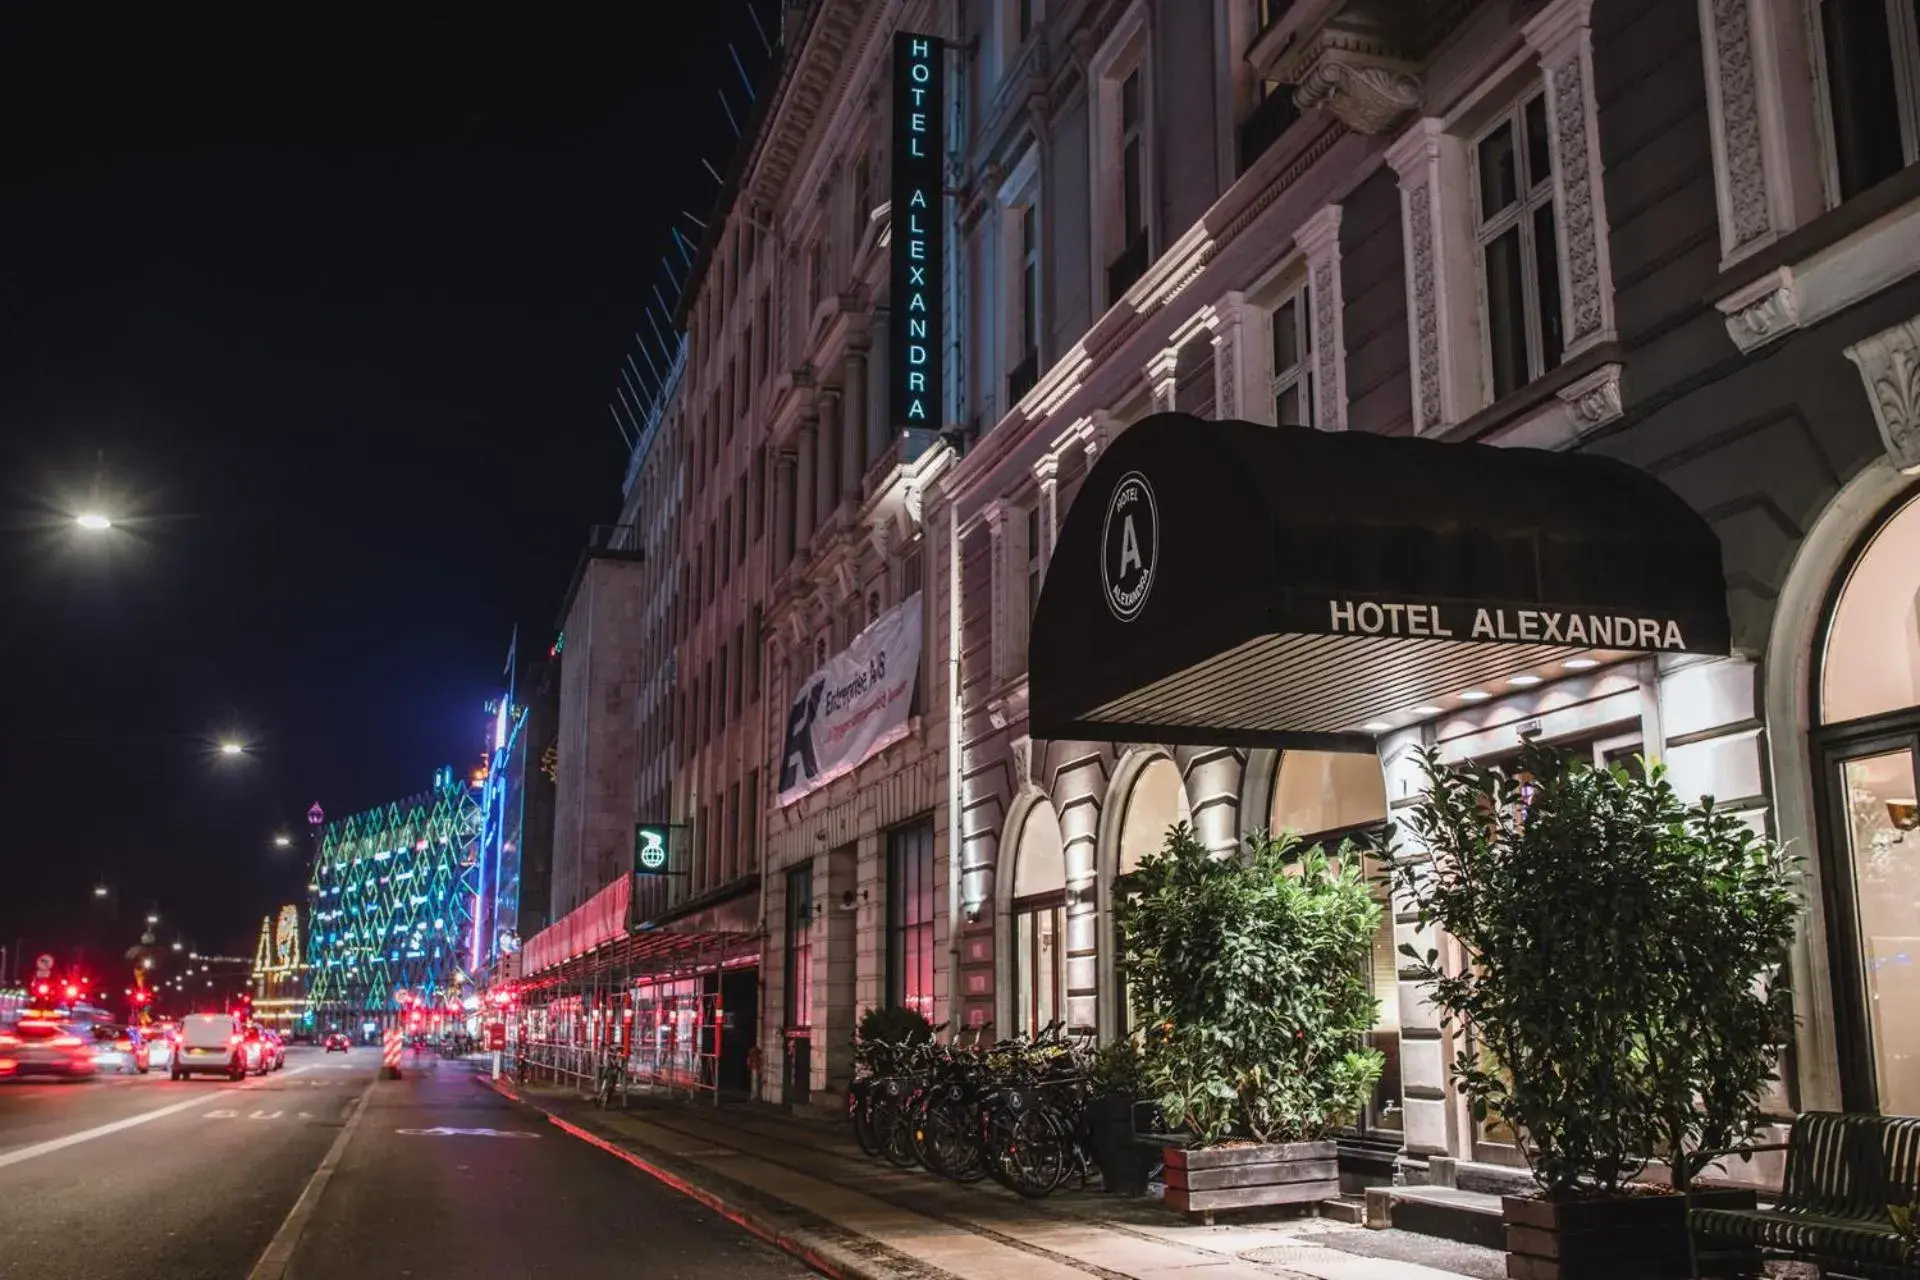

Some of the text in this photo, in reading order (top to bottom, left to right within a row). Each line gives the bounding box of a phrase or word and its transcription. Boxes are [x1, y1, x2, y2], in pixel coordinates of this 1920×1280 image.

[909, 39, 929, 419] HOTEL ALEXANDRA
[1117, 487, 1138, 513] HOTEL
[1120, 515, 1141, 579] A
[1113, 568, 1149, 606] ALEXANDRA
[1329, 600, 1686, 650] HOTEL ALEXANDRA
